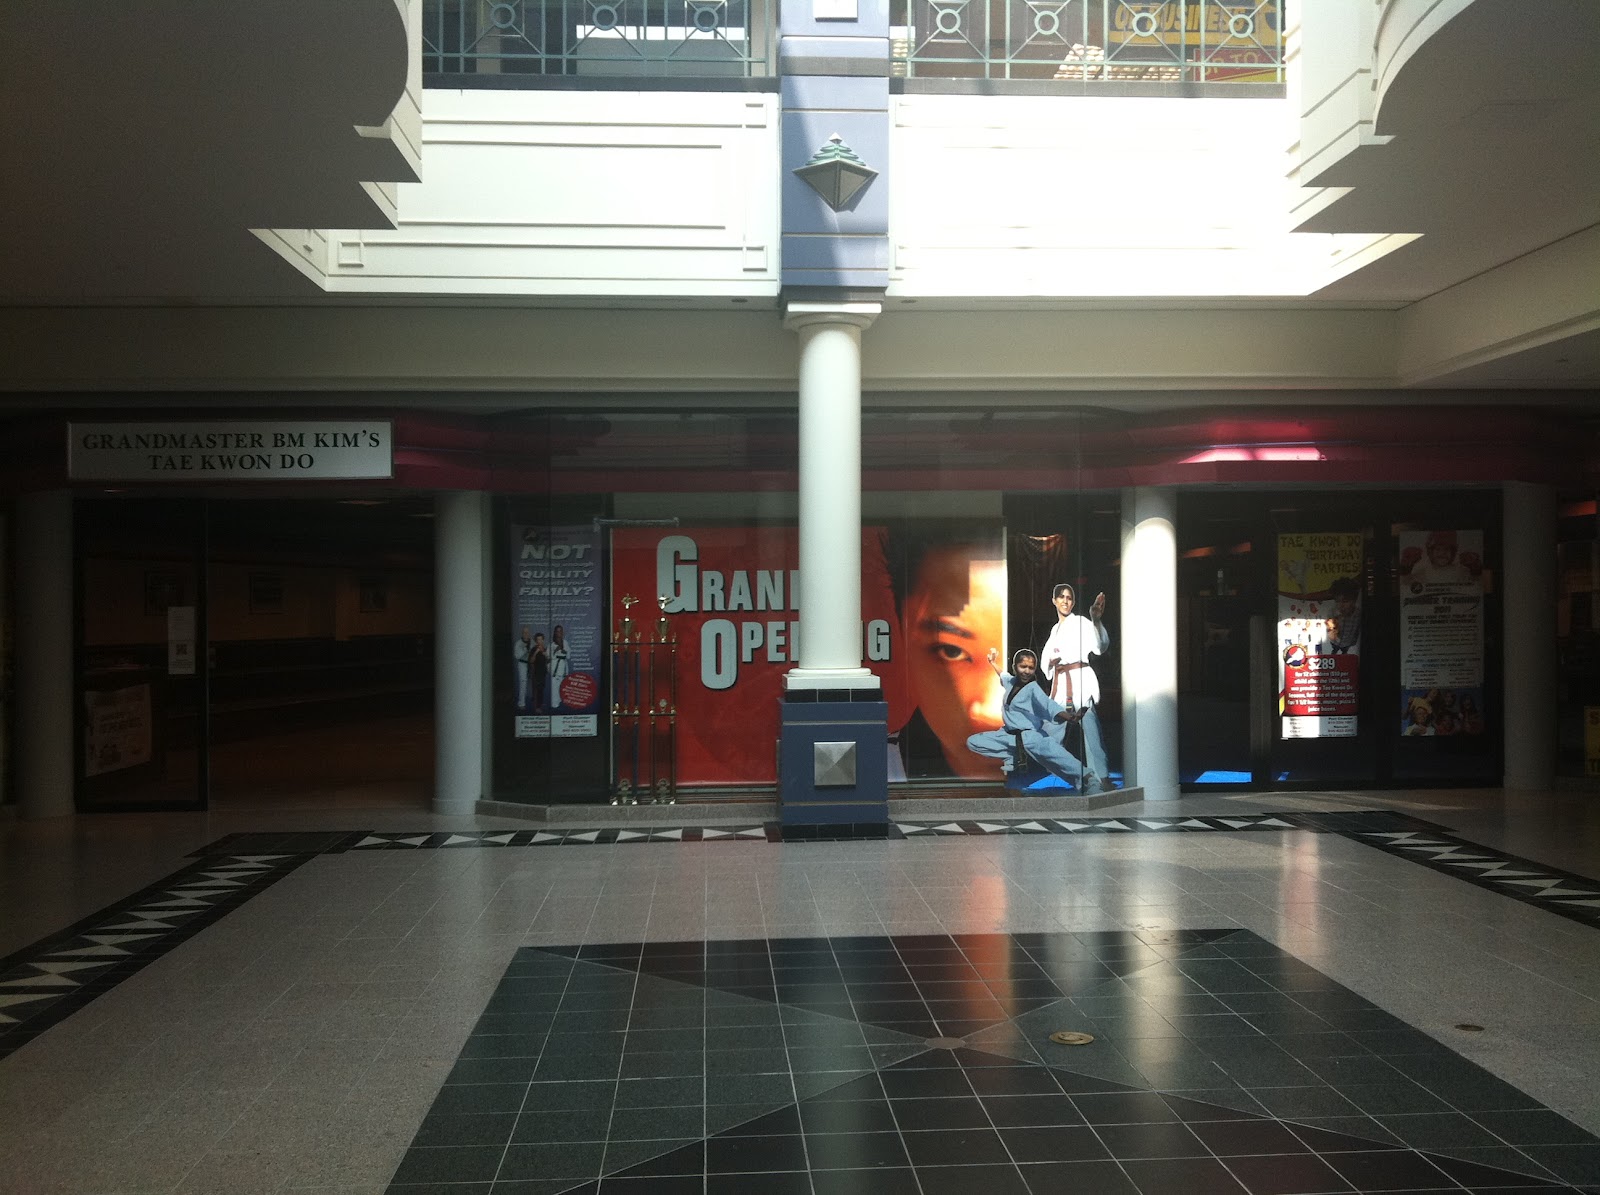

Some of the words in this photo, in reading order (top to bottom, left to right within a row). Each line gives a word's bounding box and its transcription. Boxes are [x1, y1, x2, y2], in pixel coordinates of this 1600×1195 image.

[83, 432, 264, 450] GRANDMASTER
[272, 432, 306, 448] BM
[313, 429, 380, 448] KIM'S
[148, 454, 193, 470] TAE
[200, 454, 272, 470] KWON
[280, 453, 314, 469] DO
[1280, 536, 1304, 548] TAE
[1310, 536, 1340, 547] KWON
[520, 544, 592, 560] NOT
[519, 570, 592, 578] QUALITY
[656, 535, 800, 614] GRAN
[519, 586, 594, 596] FAMILY?
[701, 618, 891, 690] OPEG
[1308, 658, 1335, 670] $289
